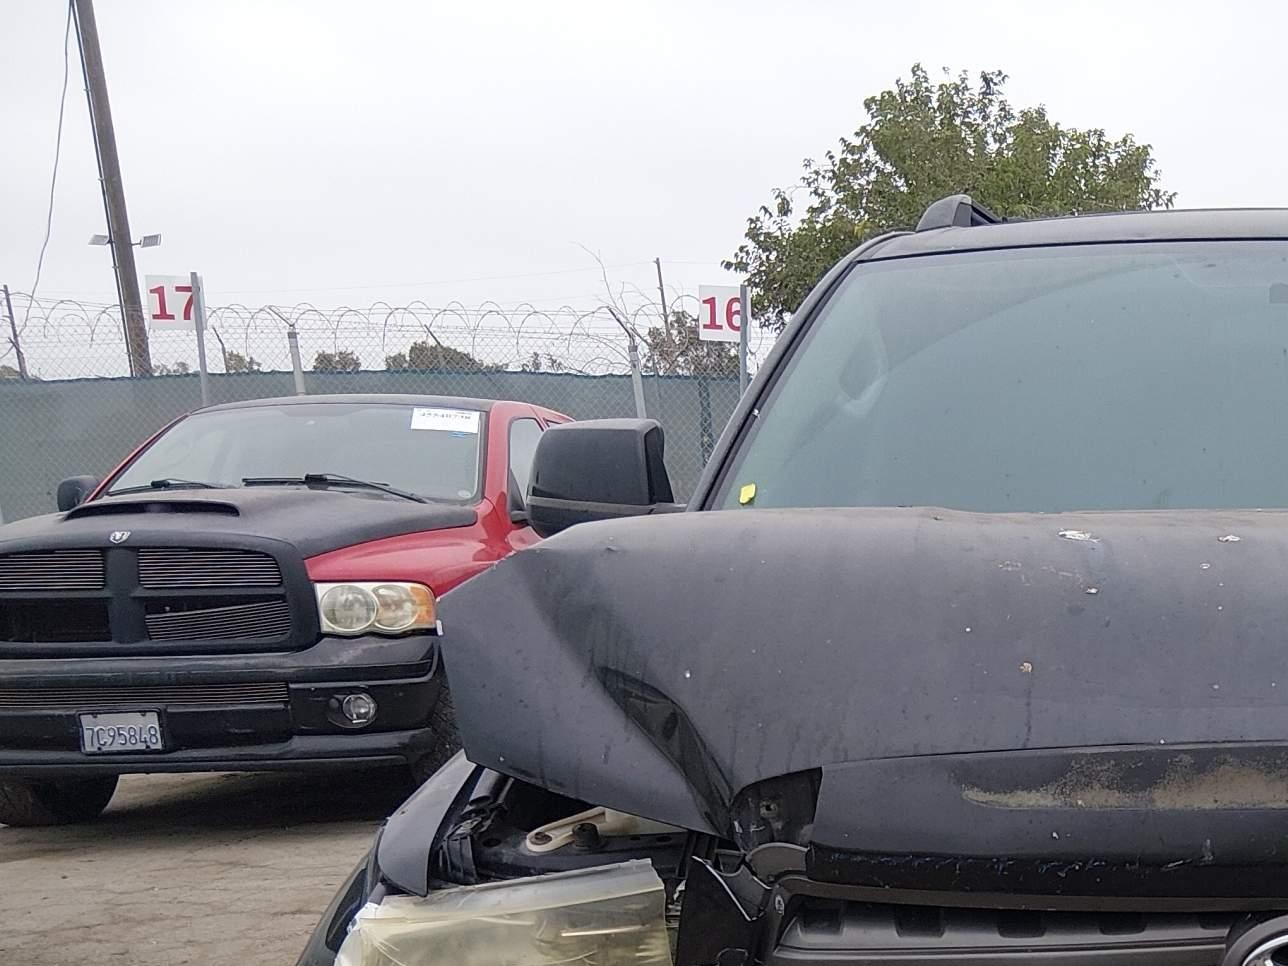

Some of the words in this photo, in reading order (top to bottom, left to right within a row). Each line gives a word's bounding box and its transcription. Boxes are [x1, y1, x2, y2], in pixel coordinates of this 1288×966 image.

[149, 285, 197, 321] 17
[702, 296, 743, 332] 16
[85, 724, 159, 747] 7C95848
